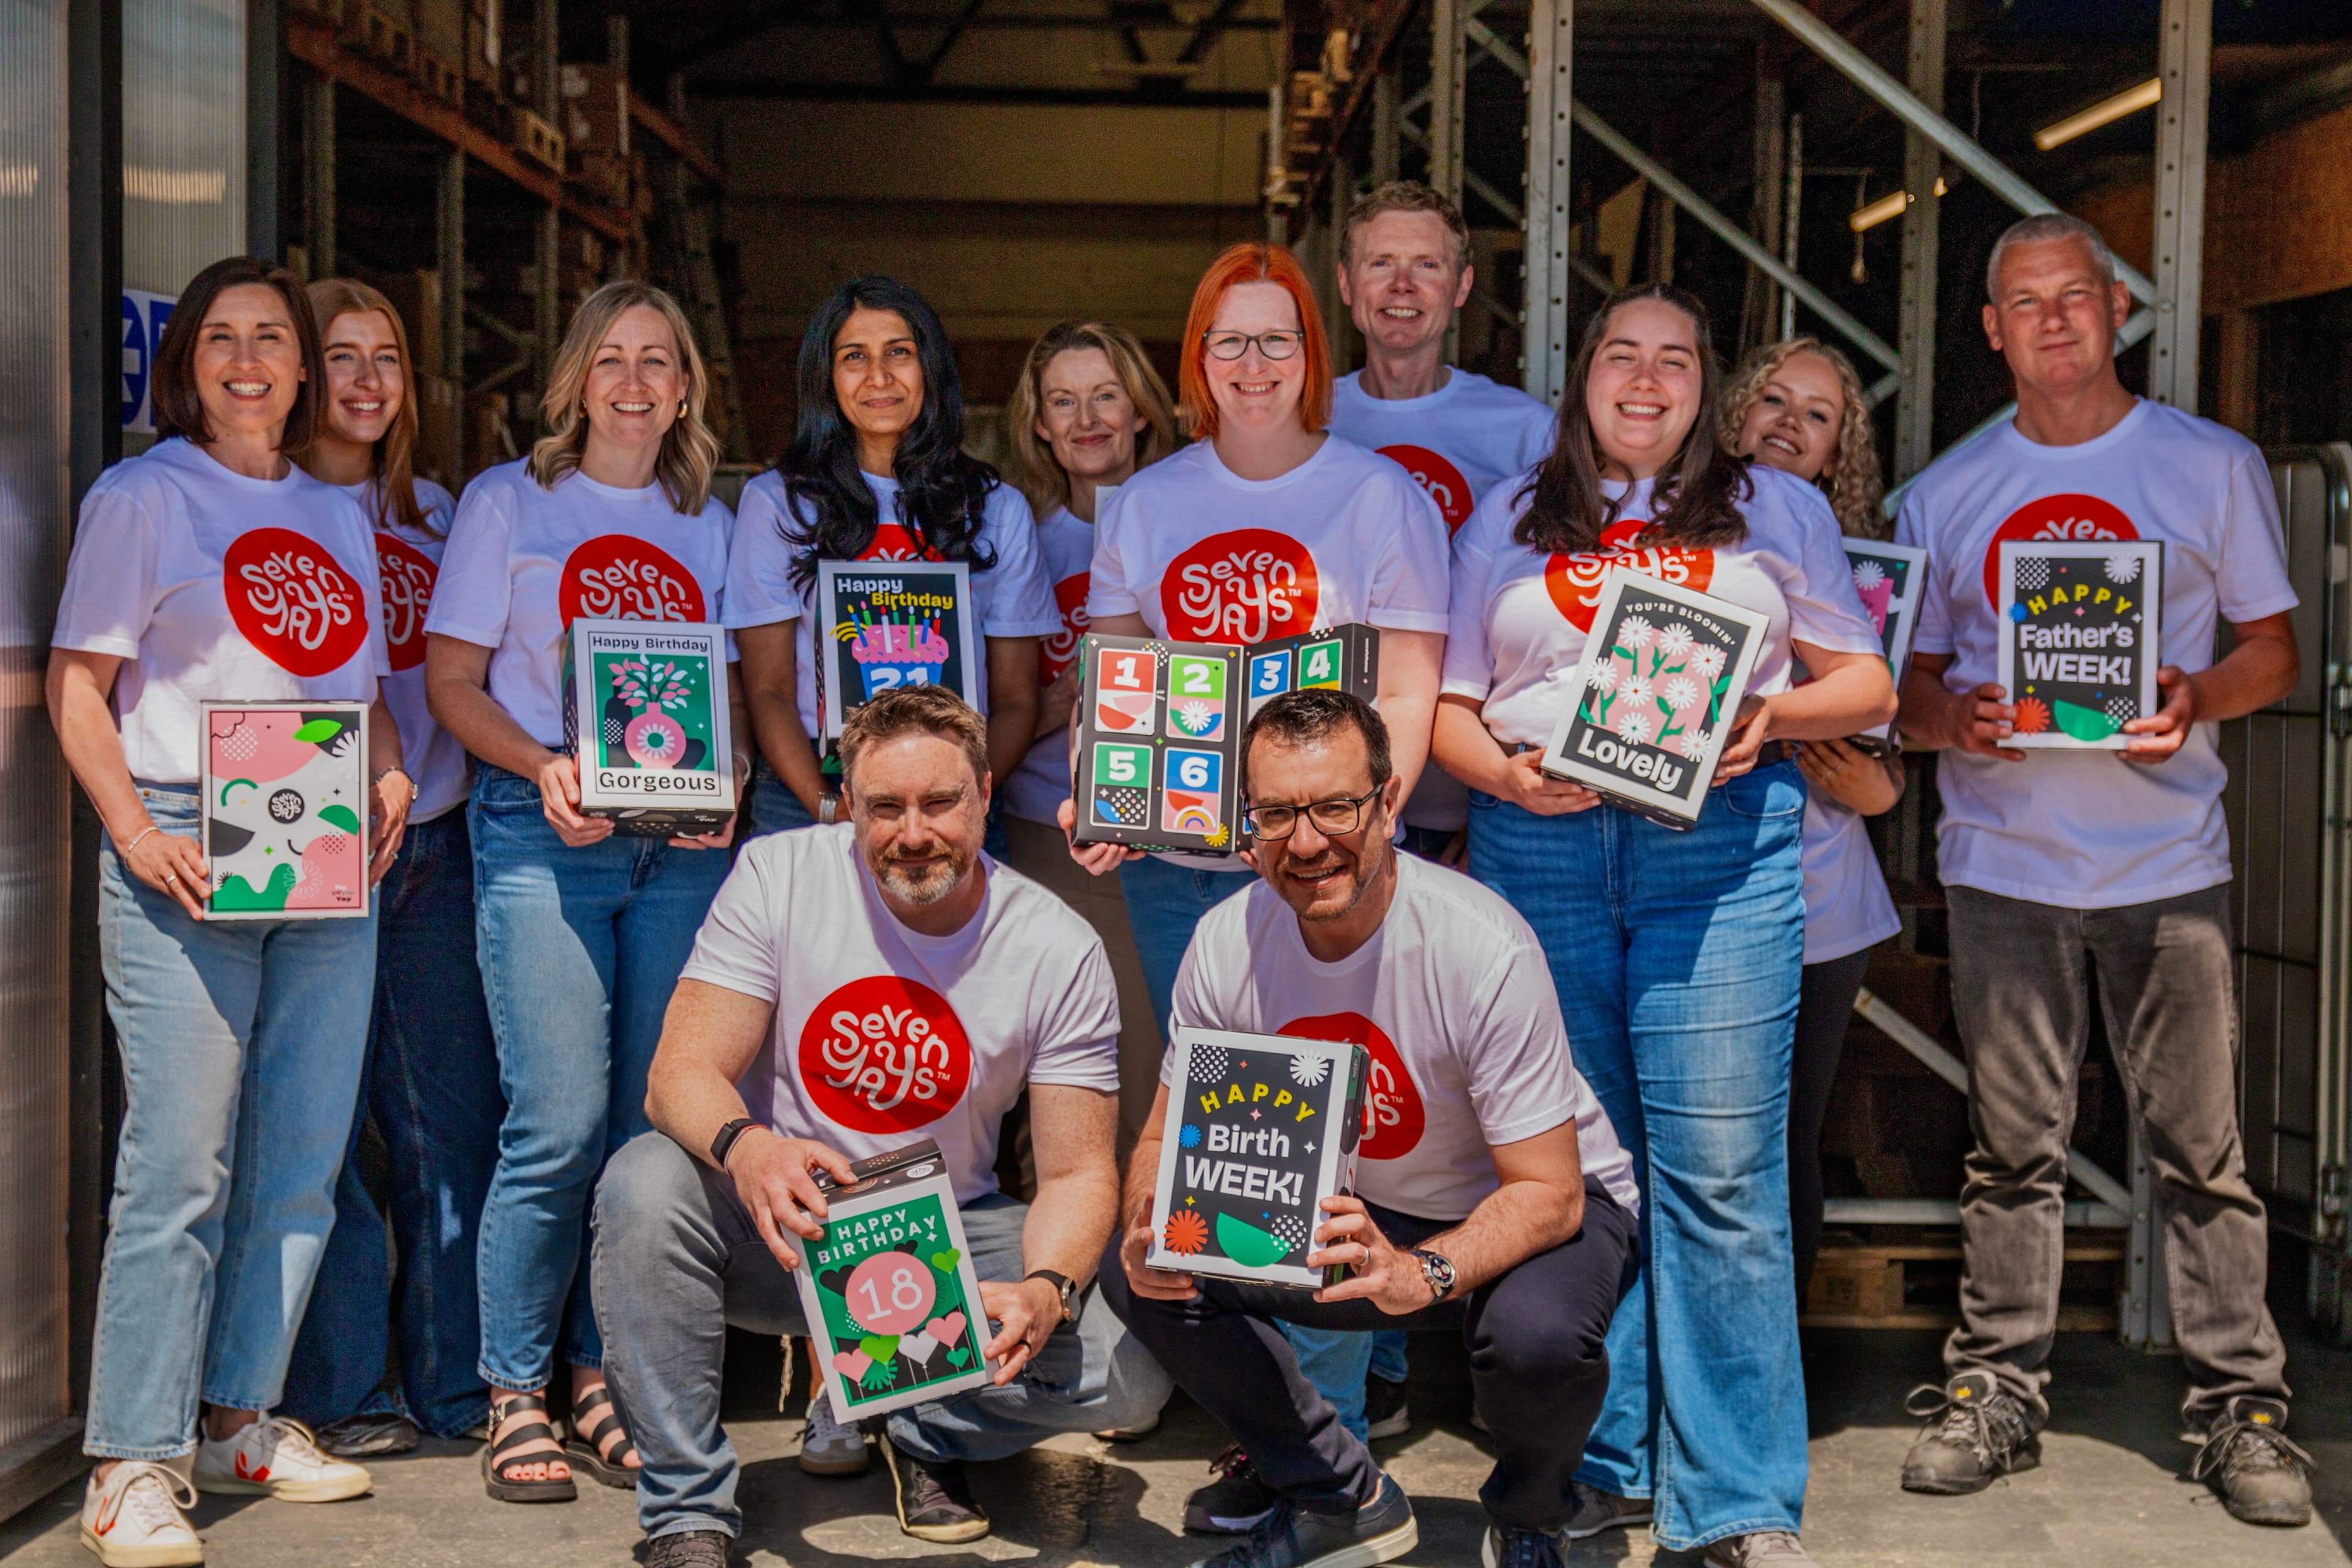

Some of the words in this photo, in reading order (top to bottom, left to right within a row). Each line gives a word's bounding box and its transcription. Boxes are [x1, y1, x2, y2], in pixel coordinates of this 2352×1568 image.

[837, 578, 903, 594] Happy
[872, 592, 954, 609] Birthday
[2027, 584, 2133, 616] HAPPY
[1626, 601, 1674, 613] YOU'RE
[1679, 606, 1736, 646] BLOOMIN'
[2019, 621, 2134, 649] Father's
[593, 636, 639, 649] Happy
[646, 638, 708, 652] Birthday
[1114, 657, 1140, 688] 1
[1183, 663, 1212, 693] 2
[1259, 660, 1282, 691] 3
[1307, 648, 1331, 679] 4
[2023, 651, 2132, 686] WEEK!
[870, 667, 929, 694] 21
[1109, 751, 1136, 782] 5
[1180, 756, 1208, 788] 6
[1577, 728, 1684, 792] Lovely
[600, 772, 716, 791] Gorgeous
[831, 1004, 949, 1069] Seven
[1199, 1083, 1316, 1122] HAPPY
[1207, 1123, 1290, 1158] Birth
[1185, 1155, 1305, 1206] WEEK!
[817, 1215, 936, 1265] BIRTHDAY
[837, 1208, 907, 1240] HAPPY
[858, 1268, 922, 1321] 18
